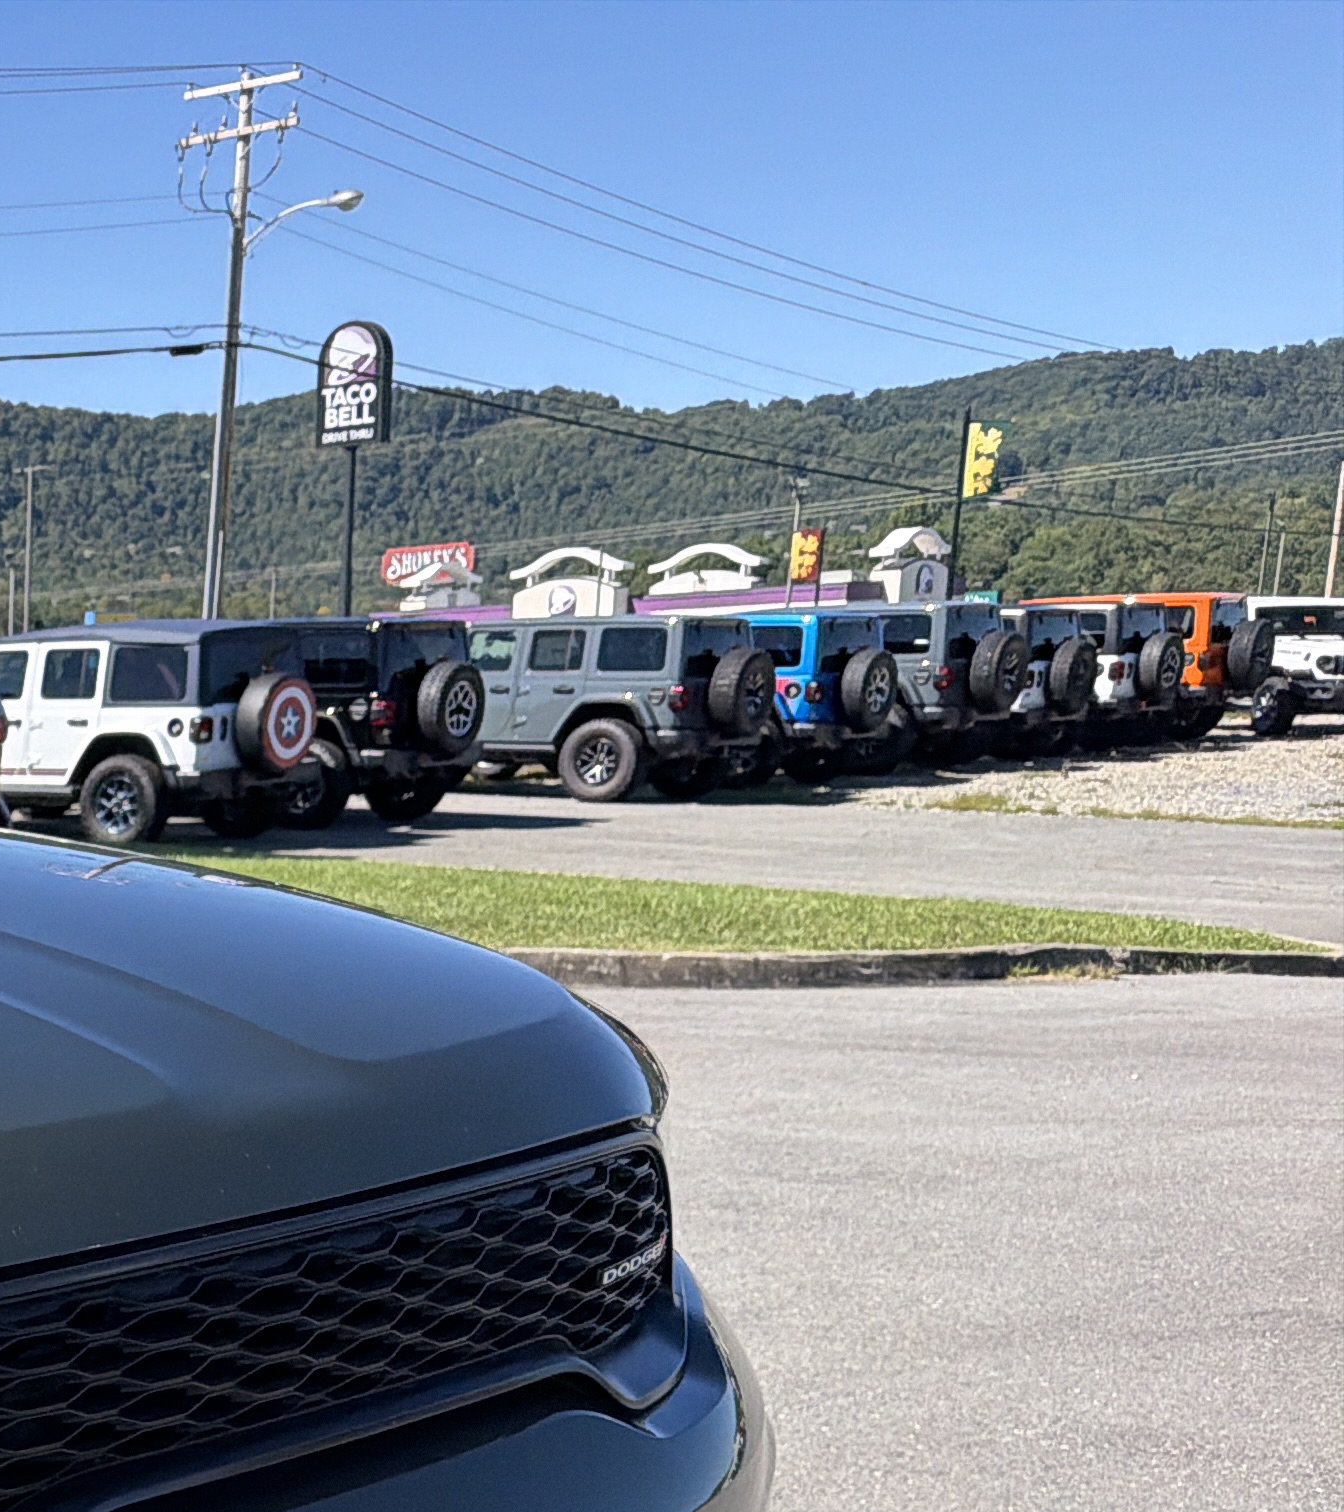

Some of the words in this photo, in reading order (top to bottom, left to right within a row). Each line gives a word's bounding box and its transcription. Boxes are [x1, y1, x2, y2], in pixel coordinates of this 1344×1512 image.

[321, 382, 377, 408] TACO
[324, 403, 376, 429] BELL
[602, 1241, 665, 1285] DODGE
